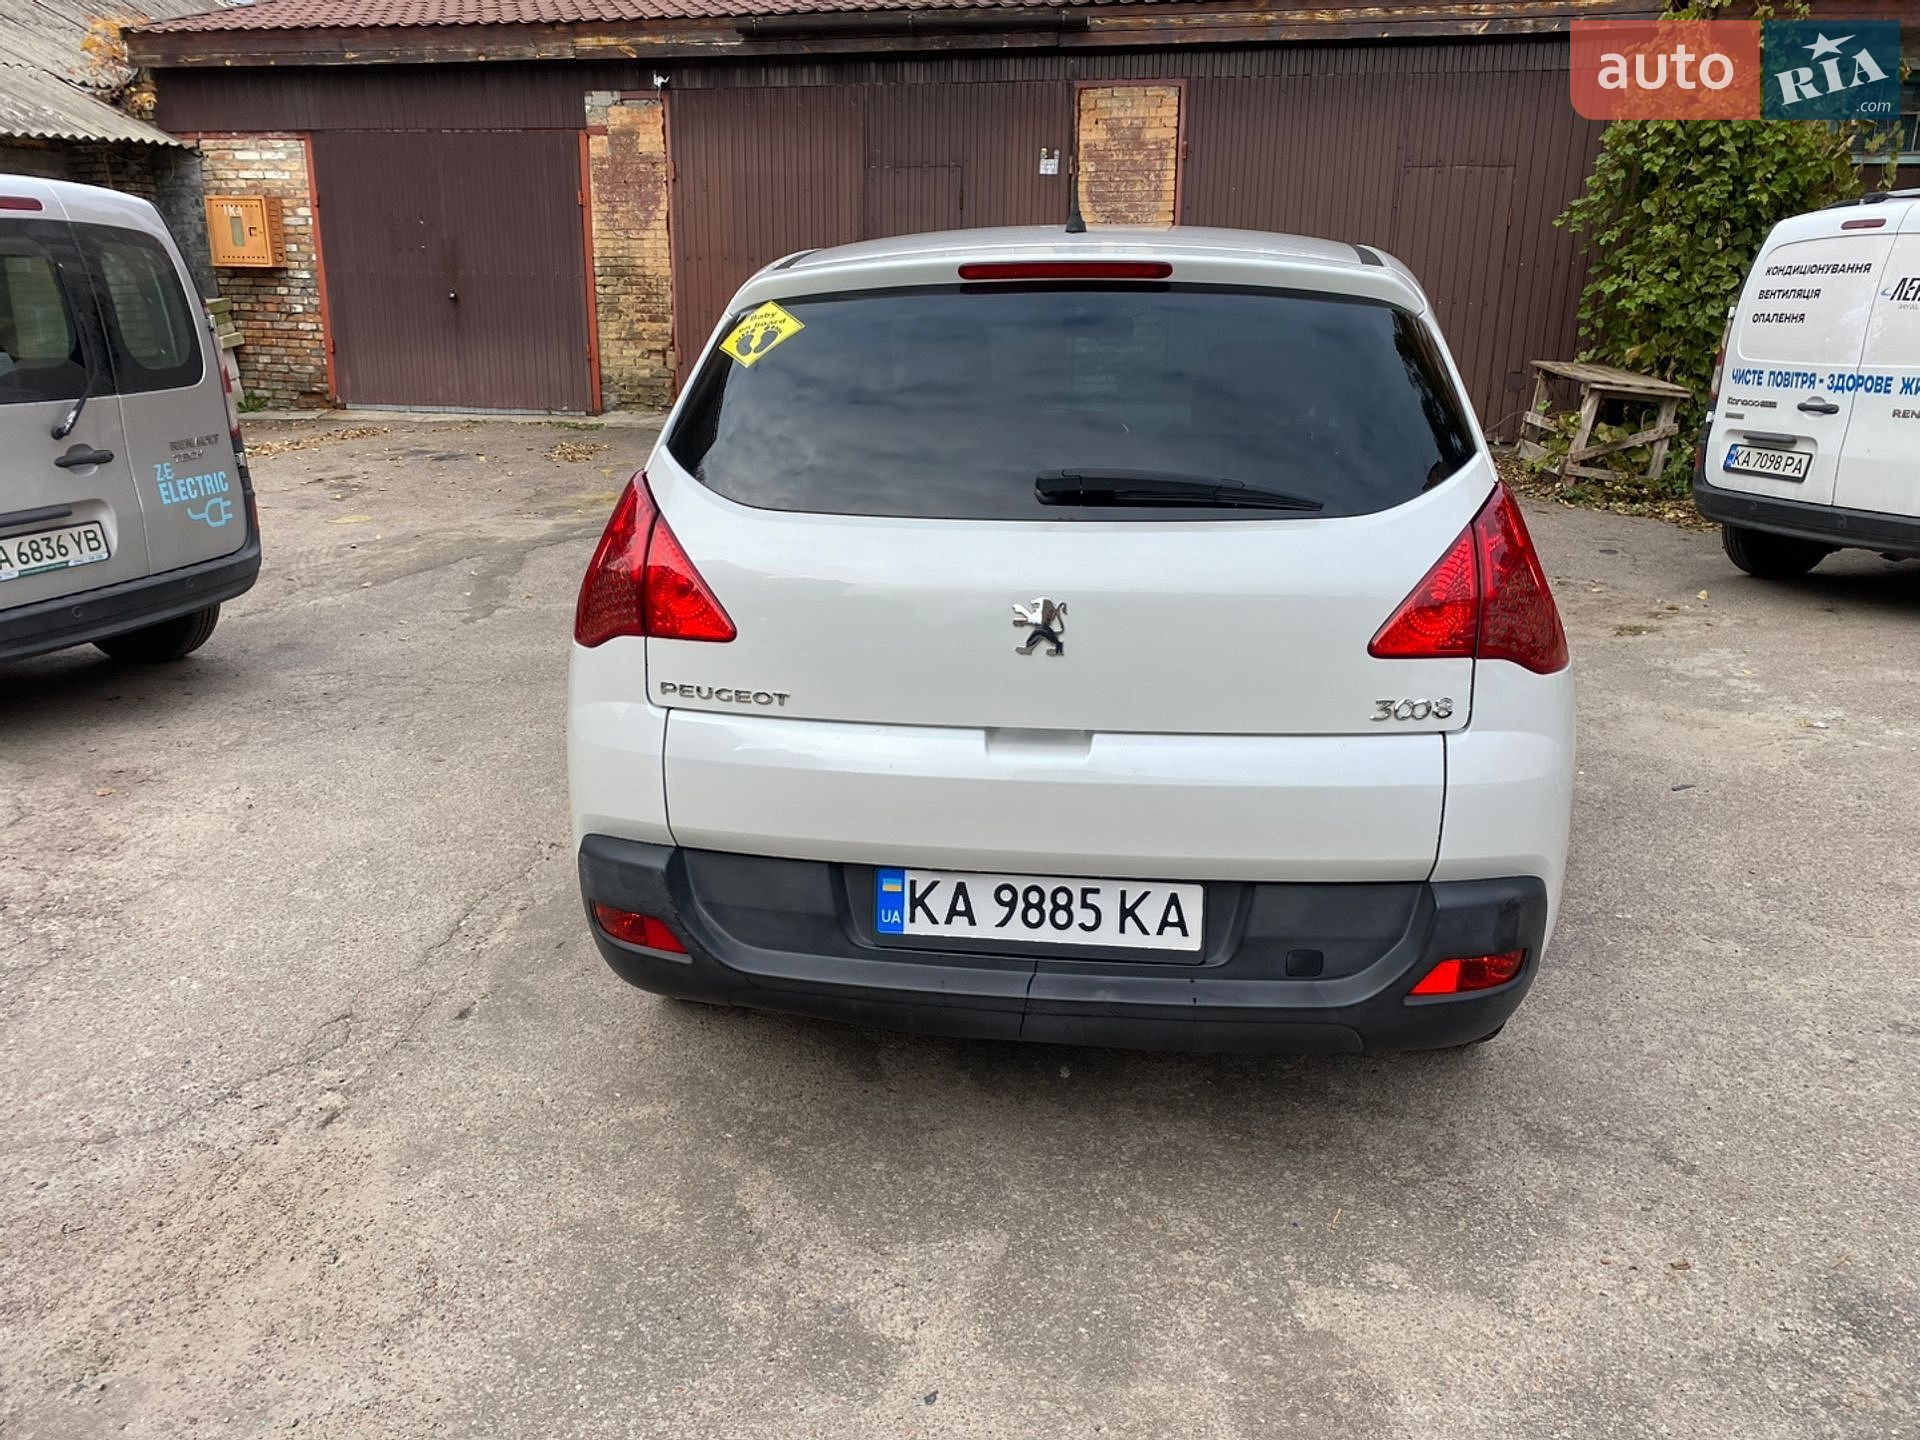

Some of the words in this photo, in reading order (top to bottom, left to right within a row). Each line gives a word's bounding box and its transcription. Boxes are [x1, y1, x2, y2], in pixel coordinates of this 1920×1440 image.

[1765, 262, 1872, 276] КОНДИЦІОНУВАННЯ
[1758, 288, 1821, 300] ВЕНТИЛЯЦІЯ
[1752, 313, 1806, 324] ОПАЛЕННЯ
[1732, 368, 1764, 387] ЧИСТЕ
[1767, 370, 1817, 390] ПОВІТРЯ
[1827, 373, 1893, 395] ЗДОРОВЕ
[1753, 452, 1783, 471] 7098
[1783, 457, 1802, 474] PA
[158, 471, 229, 505] ELECTRIC
[17, 535, 69, 565] 6836
[69, 530, 101, 555] YB
[660, 681, 790, 706] PEUGEOT
[1370, 698, 1453, 721] 3008
[881, 909, 901, 924] UA
[909, 879, 977, 927] KA
[993, 883, 1102, 932] 9885
[1119, 889, 1189, 937] KA
